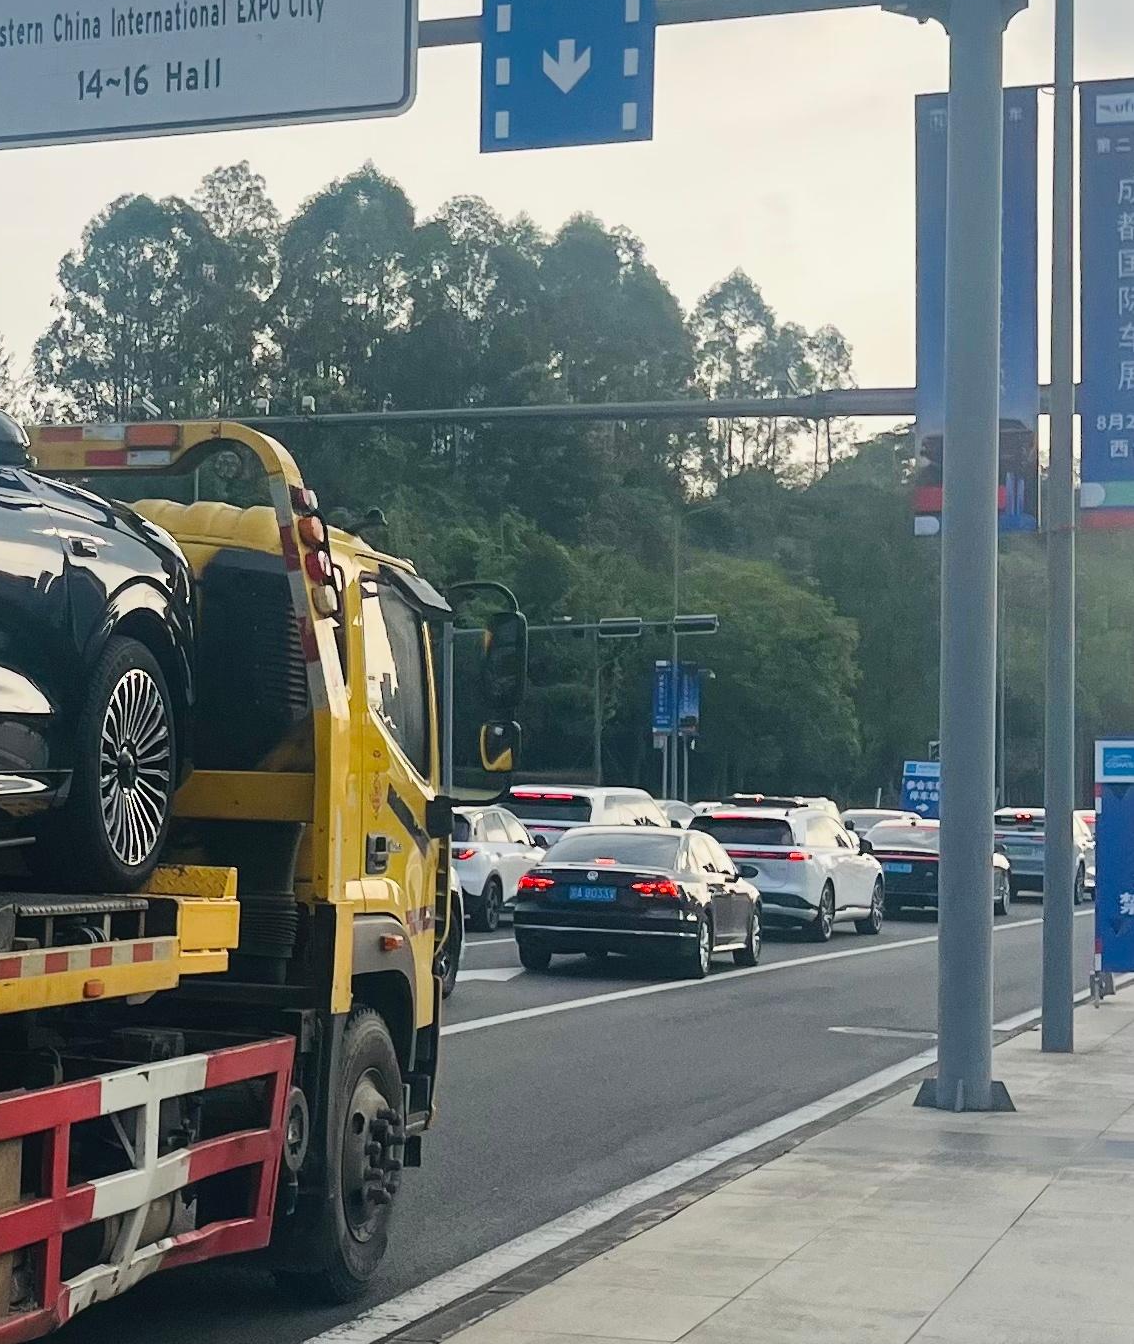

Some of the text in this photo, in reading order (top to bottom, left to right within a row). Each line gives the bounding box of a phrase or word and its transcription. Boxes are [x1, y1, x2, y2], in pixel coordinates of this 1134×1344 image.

[53, 10, 102, 43] China
[78, 57, 222, 101] 14~16 Hall
